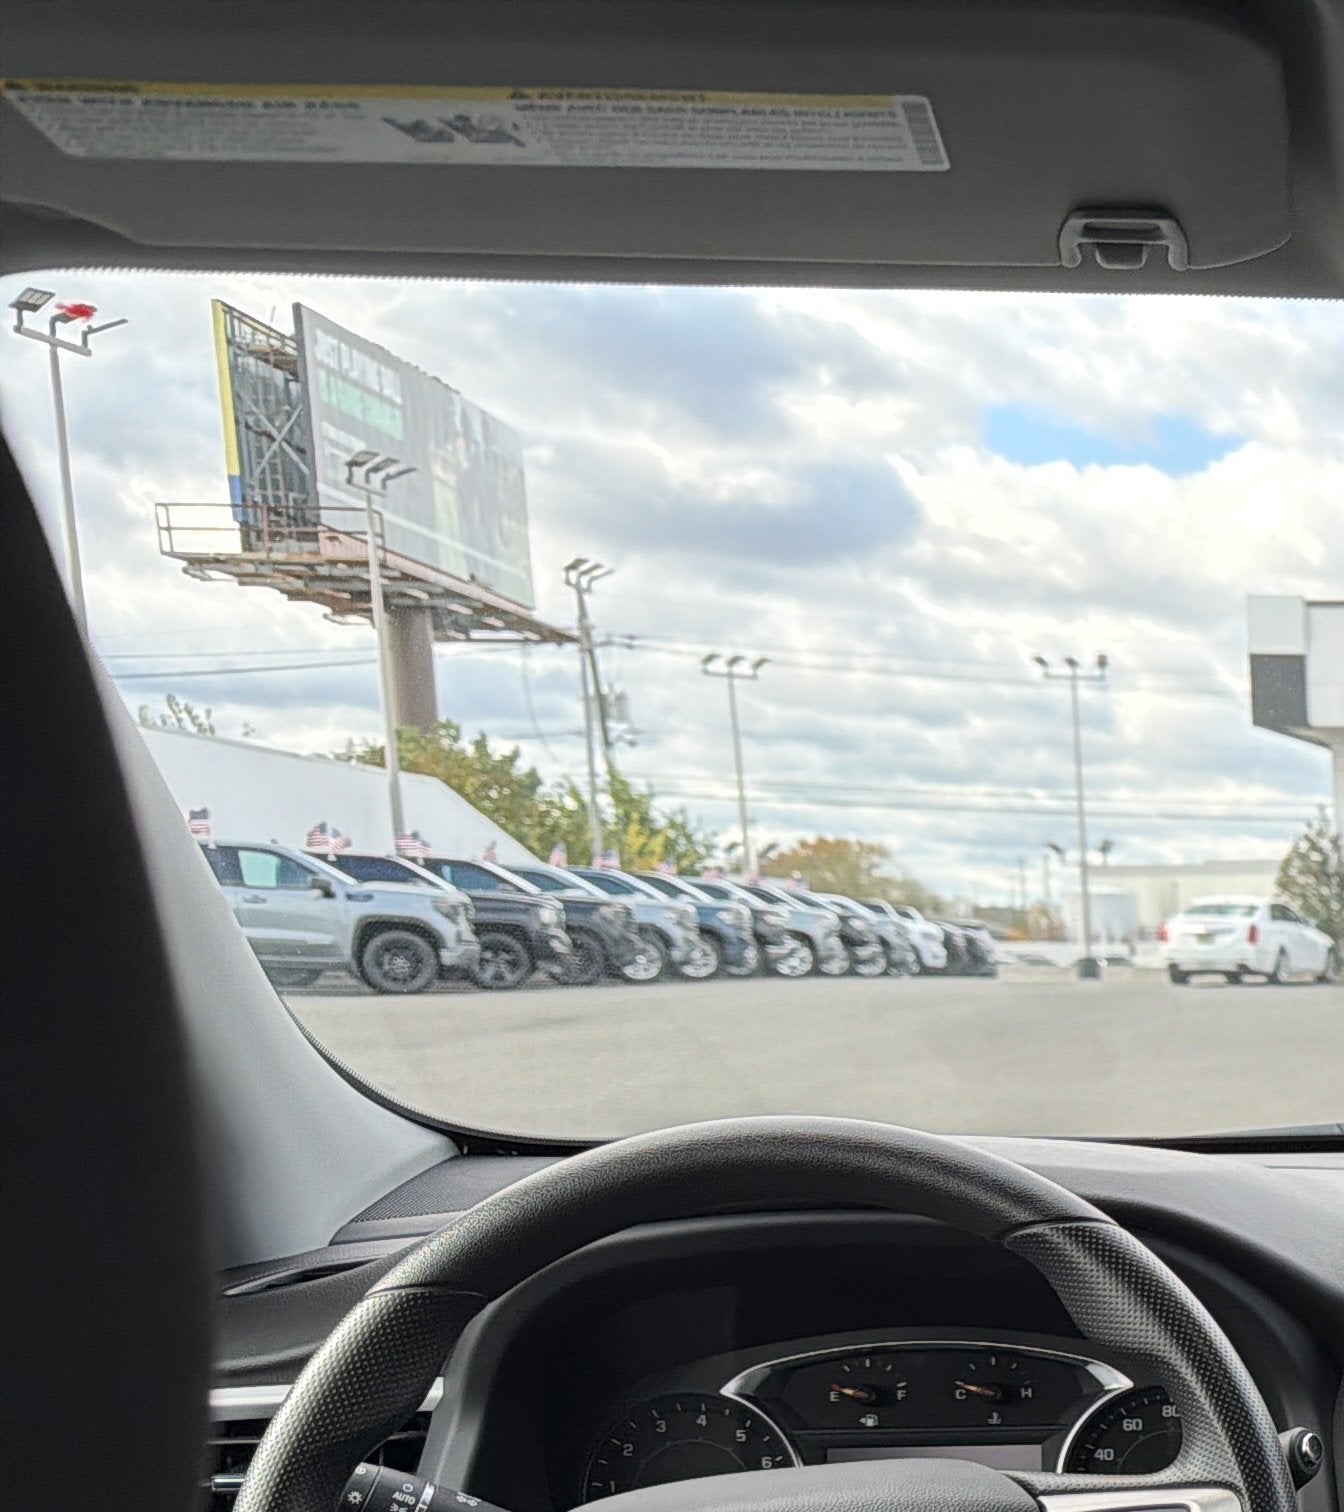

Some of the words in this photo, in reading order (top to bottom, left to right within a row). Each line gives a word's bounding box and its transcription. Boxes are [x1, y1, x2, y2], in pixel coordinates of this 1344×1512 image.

[897, 1390, 906, 1401] F
[955, 1389, 966, 1401] C
[1021, 1388, 1032, 1399] H
[696, 1415, 707, 1426] 4
[1123, 1419, 1142, 1431] 60
[656, 1421, 666, 1432] 3
[736, 1430, 746, 1441] 5
[623, 1444, 633, 1456] 2
[1094, 1449, 1114, 1460] 40
[761, 1457, 772, 1468] 6
[610, 1481, 615, 1492] 1
[392, 1491, 416, 1506] AUTO
